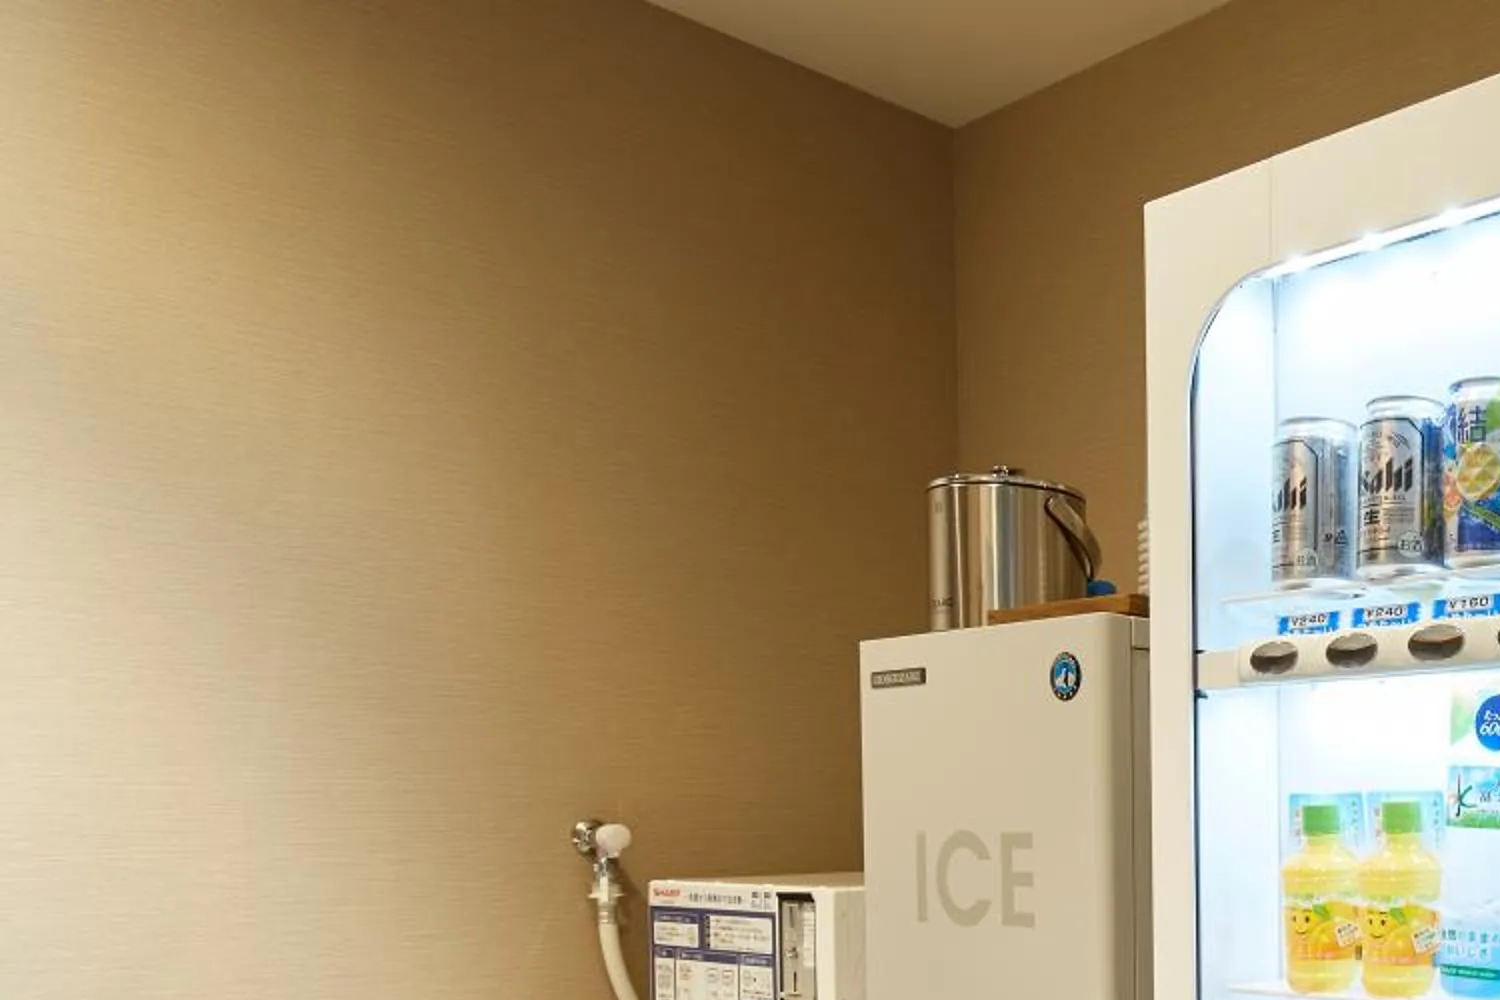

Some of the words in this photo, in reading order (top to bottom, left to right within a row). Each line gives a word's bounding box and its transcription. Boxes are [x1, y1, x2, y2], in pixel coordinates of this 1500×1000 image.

[1457, 405, 1487, 444] 結
[1363, 457, 1413, 495] sahi
[916, 829, 1035, 928] ICE
